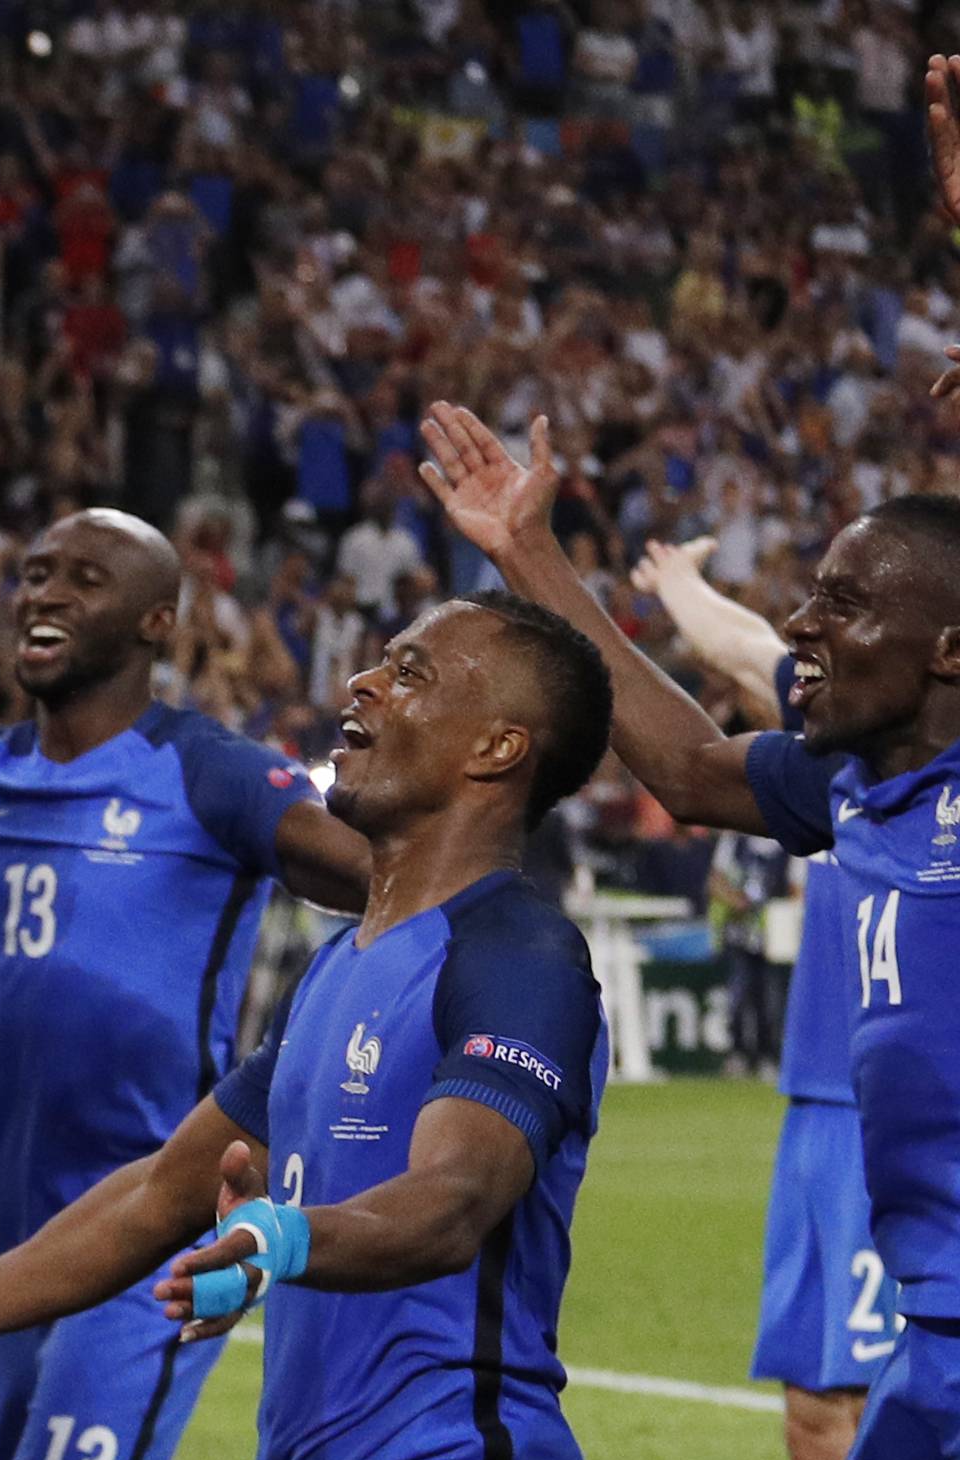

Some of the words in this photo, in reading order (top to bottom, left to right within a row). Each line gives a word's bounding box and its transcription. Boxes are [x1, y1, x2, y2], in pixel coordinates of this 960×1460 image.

[4, 863, 58, 958] 13
[857, 889, 903, 1009] 14
[494, 1044, 562, 1091] RESPECT
[847, 1248, 907, 1334] 2
